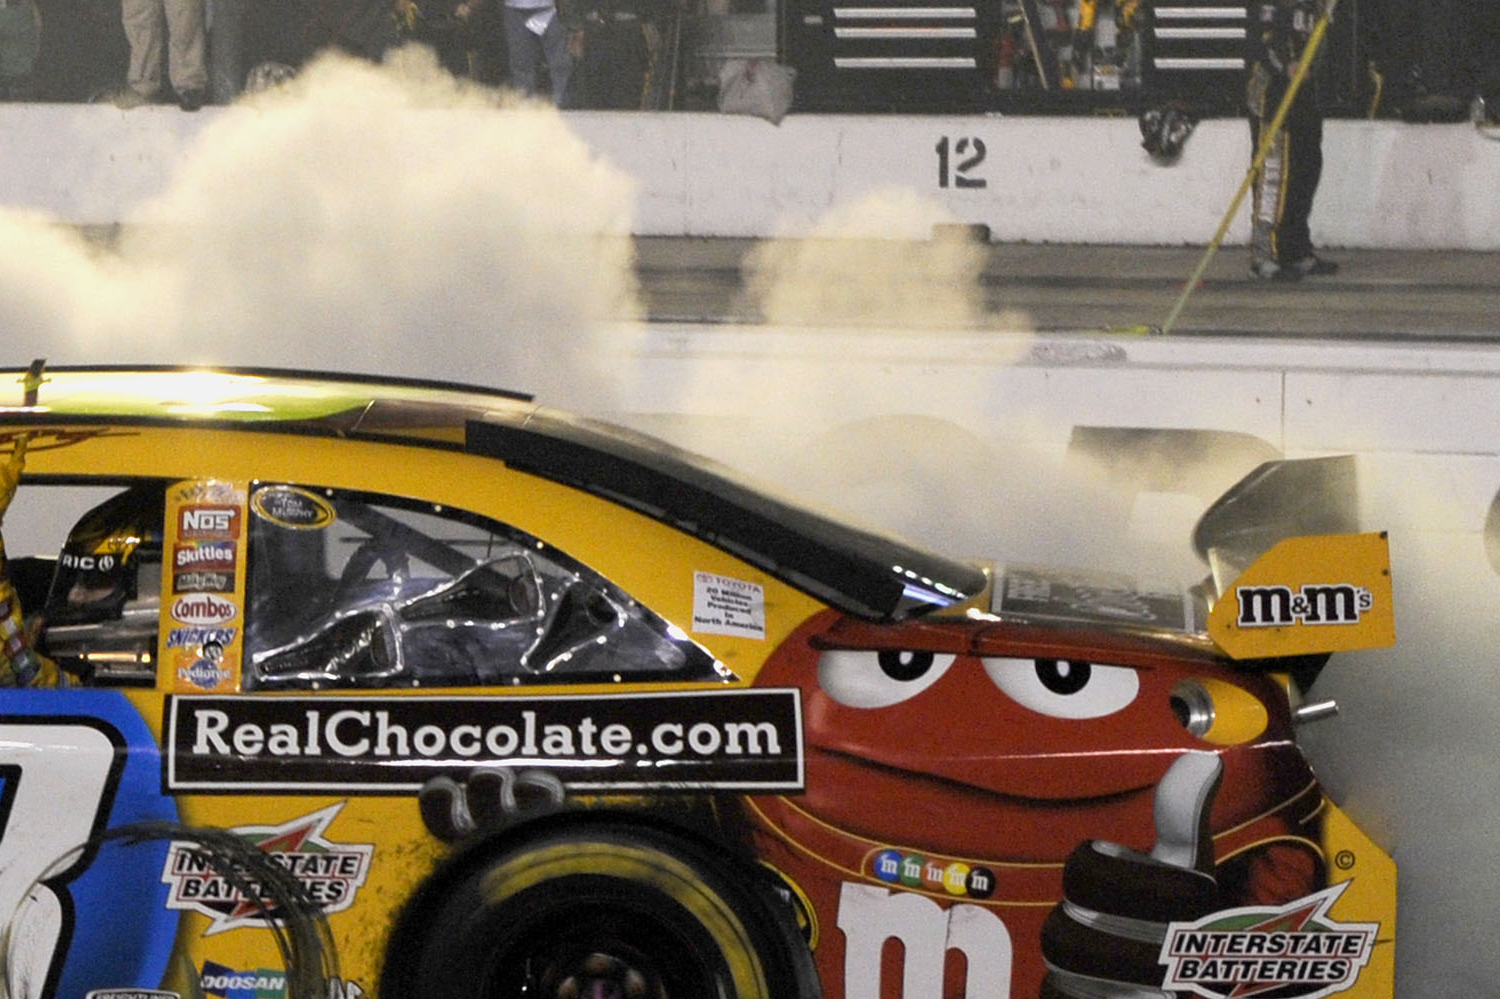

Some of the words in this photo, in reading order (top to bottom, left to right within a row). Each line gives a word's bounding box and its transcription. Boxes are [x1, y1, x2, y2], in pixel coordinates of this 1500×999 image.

[935, 136, 987, 188] 12
[177, 546, 233, 566] Skittles
[715, 576, 761, 593] TOYOTA
[710, 594, 748, 608] Vehicles
[721, 589, 752, 601] Million
[174, 596, 232, 617] Combos
[707, 602, 752, 615] Produced
[694, 616, 722, 625] North
[724, 620, 764, 631] America
[193, 709, 782, 757] RealChocolate.com
[1175, 934, 1363, 954] INTERSTATE
[1178, 960, 1349, 980] BATTERIES
[201, 976, 286, 990] DOOSAN
